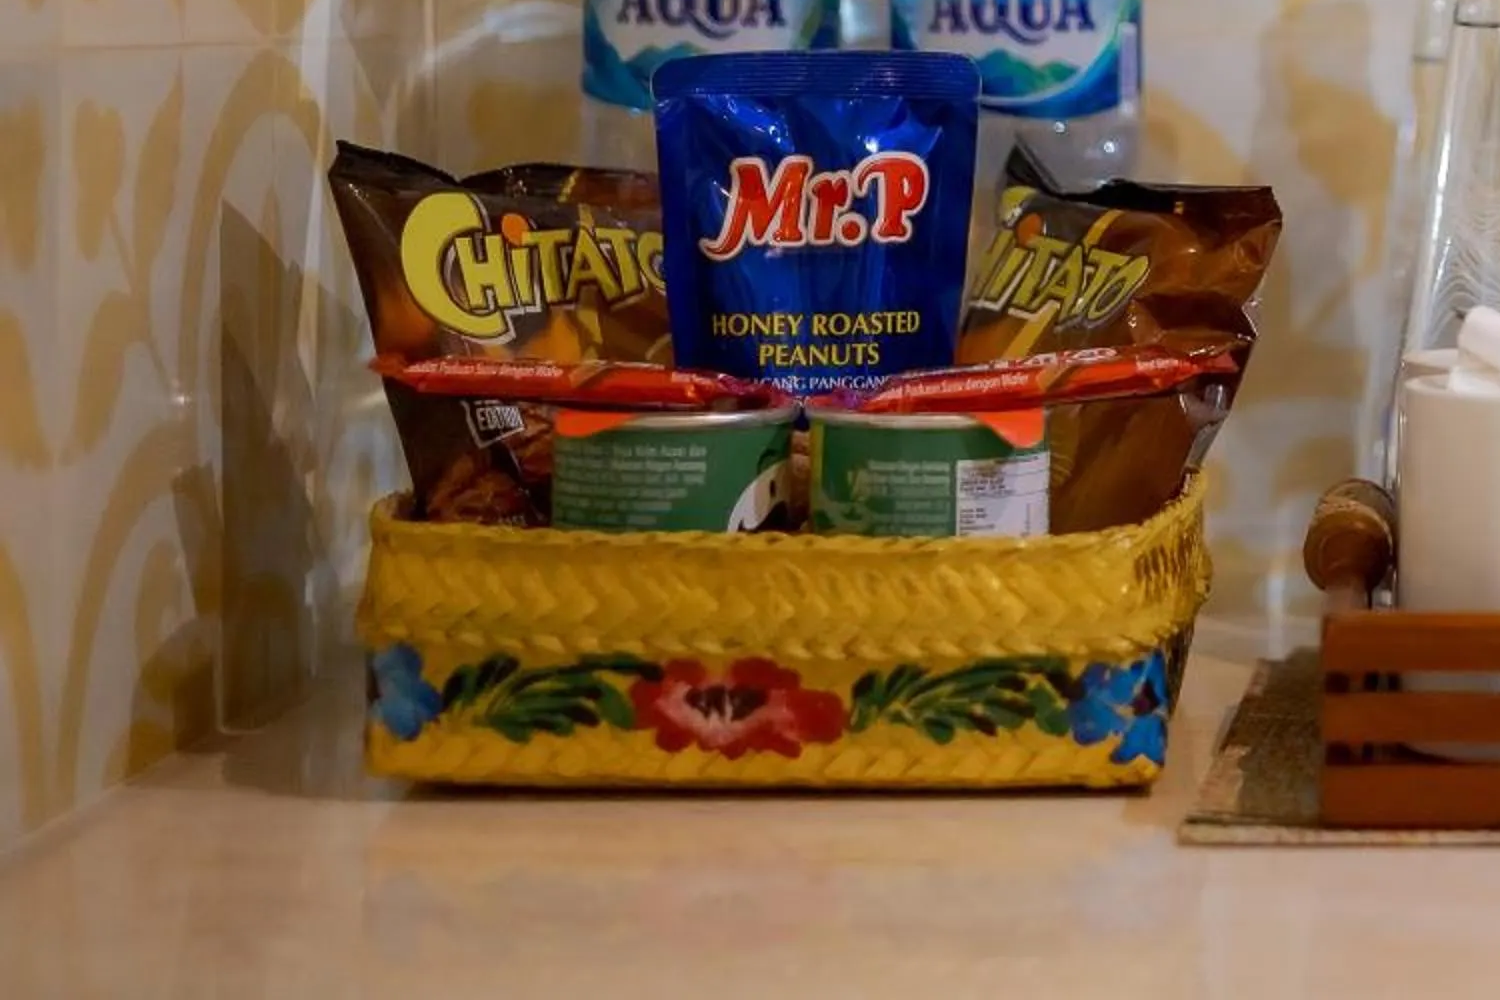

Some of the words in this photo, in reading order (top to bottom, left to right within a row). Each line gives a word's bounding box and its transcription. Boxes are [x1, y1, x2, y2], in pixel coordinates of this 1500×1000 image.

[712, 312, 804, 337] HONEY
[811, 310, 921, 336] ROASTED
[758, 342, 881, 367] PEANUTS
[808, 374, 890, 390] PANGGAN
